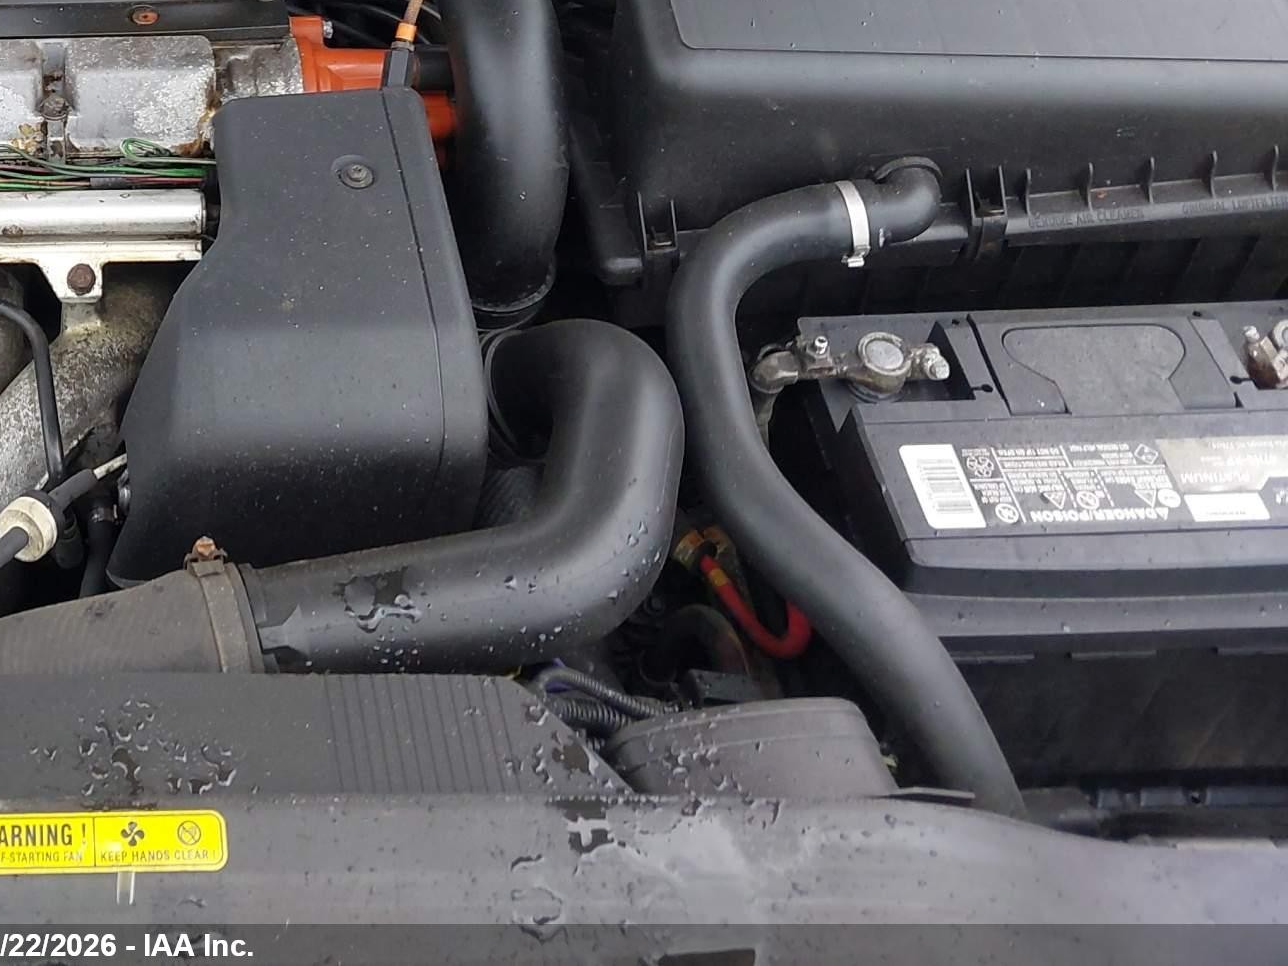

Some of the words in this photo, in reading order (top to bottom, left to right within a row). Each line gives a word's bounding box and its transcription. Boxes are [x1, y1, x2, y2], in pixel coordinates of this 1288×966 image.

[63, 851, 83, 863] FAN
[101, 850, 127, 862] KEEP
[132, 850, 170, 862] HANDS
[174, 849, 209, 861] CLEAR
